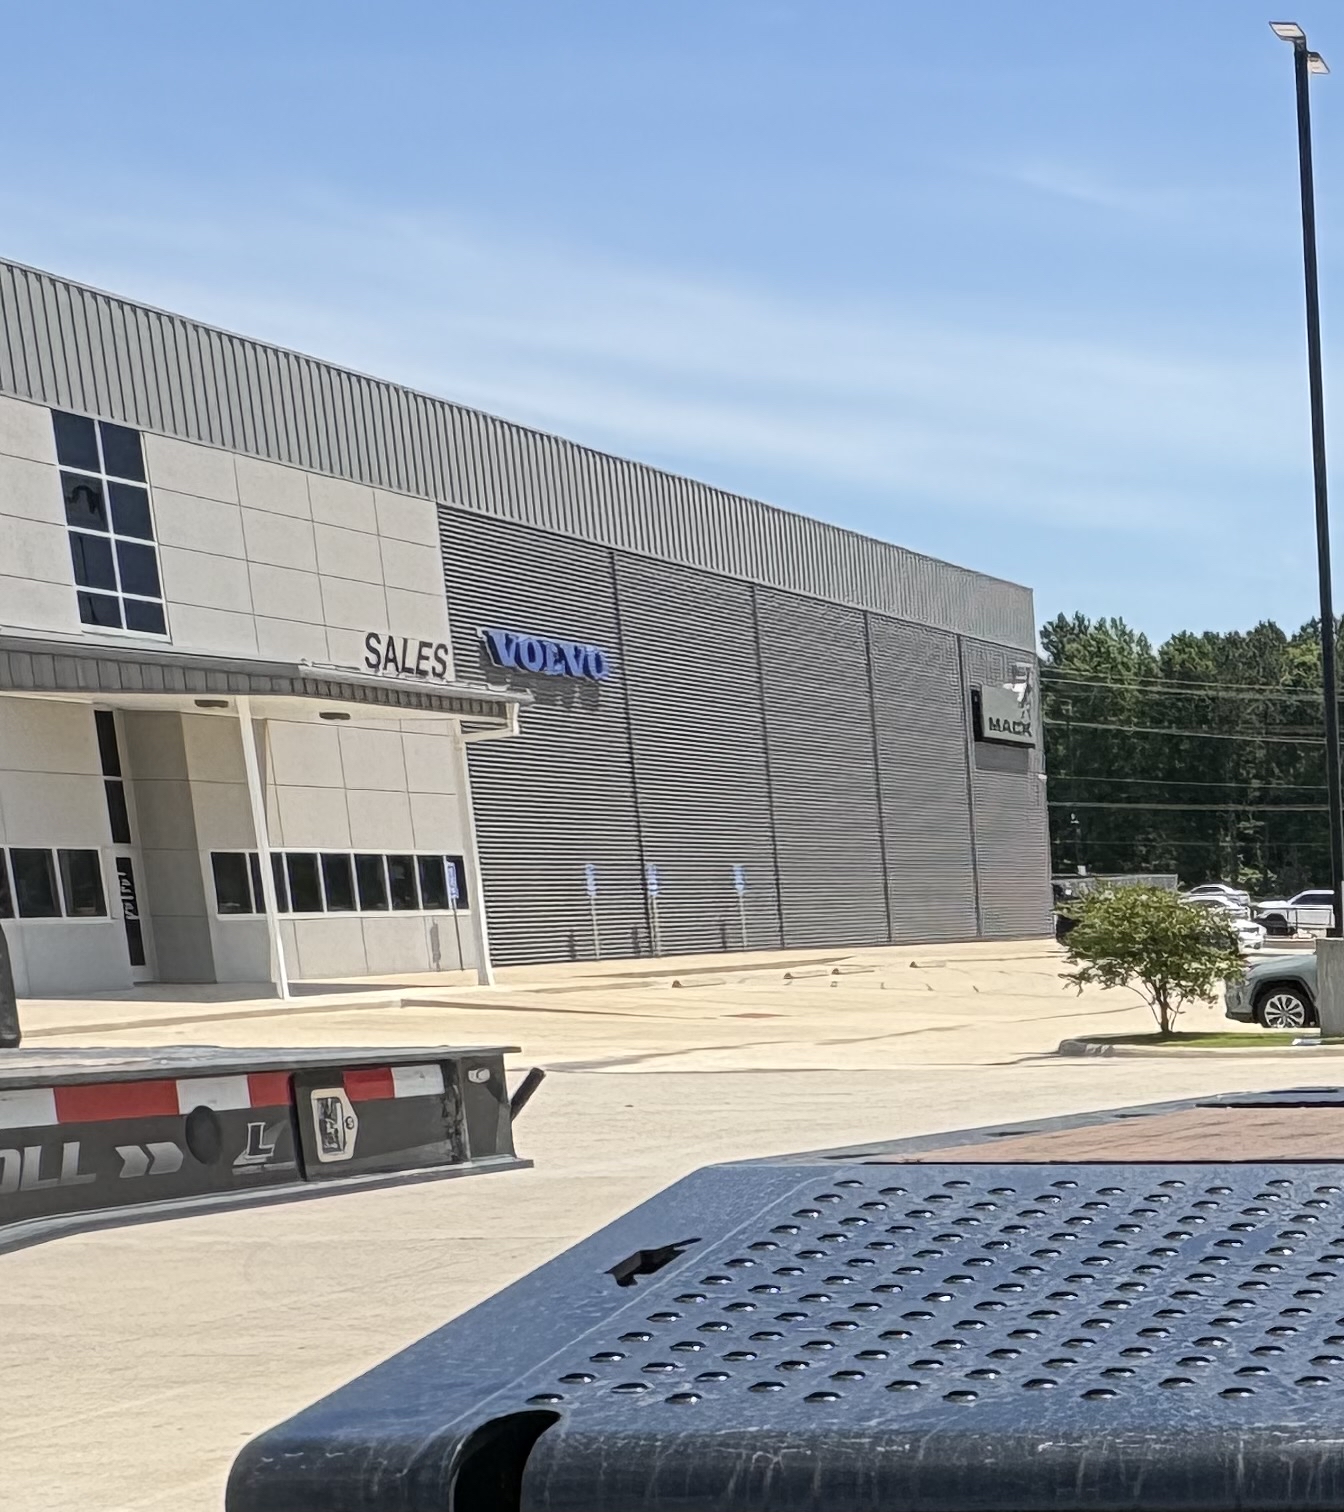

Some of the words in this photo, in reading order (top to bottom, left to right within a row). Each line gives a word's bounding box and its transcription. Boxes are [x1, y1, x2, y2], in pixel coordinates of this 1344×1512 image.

[365, 632, 448, 678] SALES
[482, 628, 610, 681] VOLVO
[988, 716, 1032, 737] MACK
